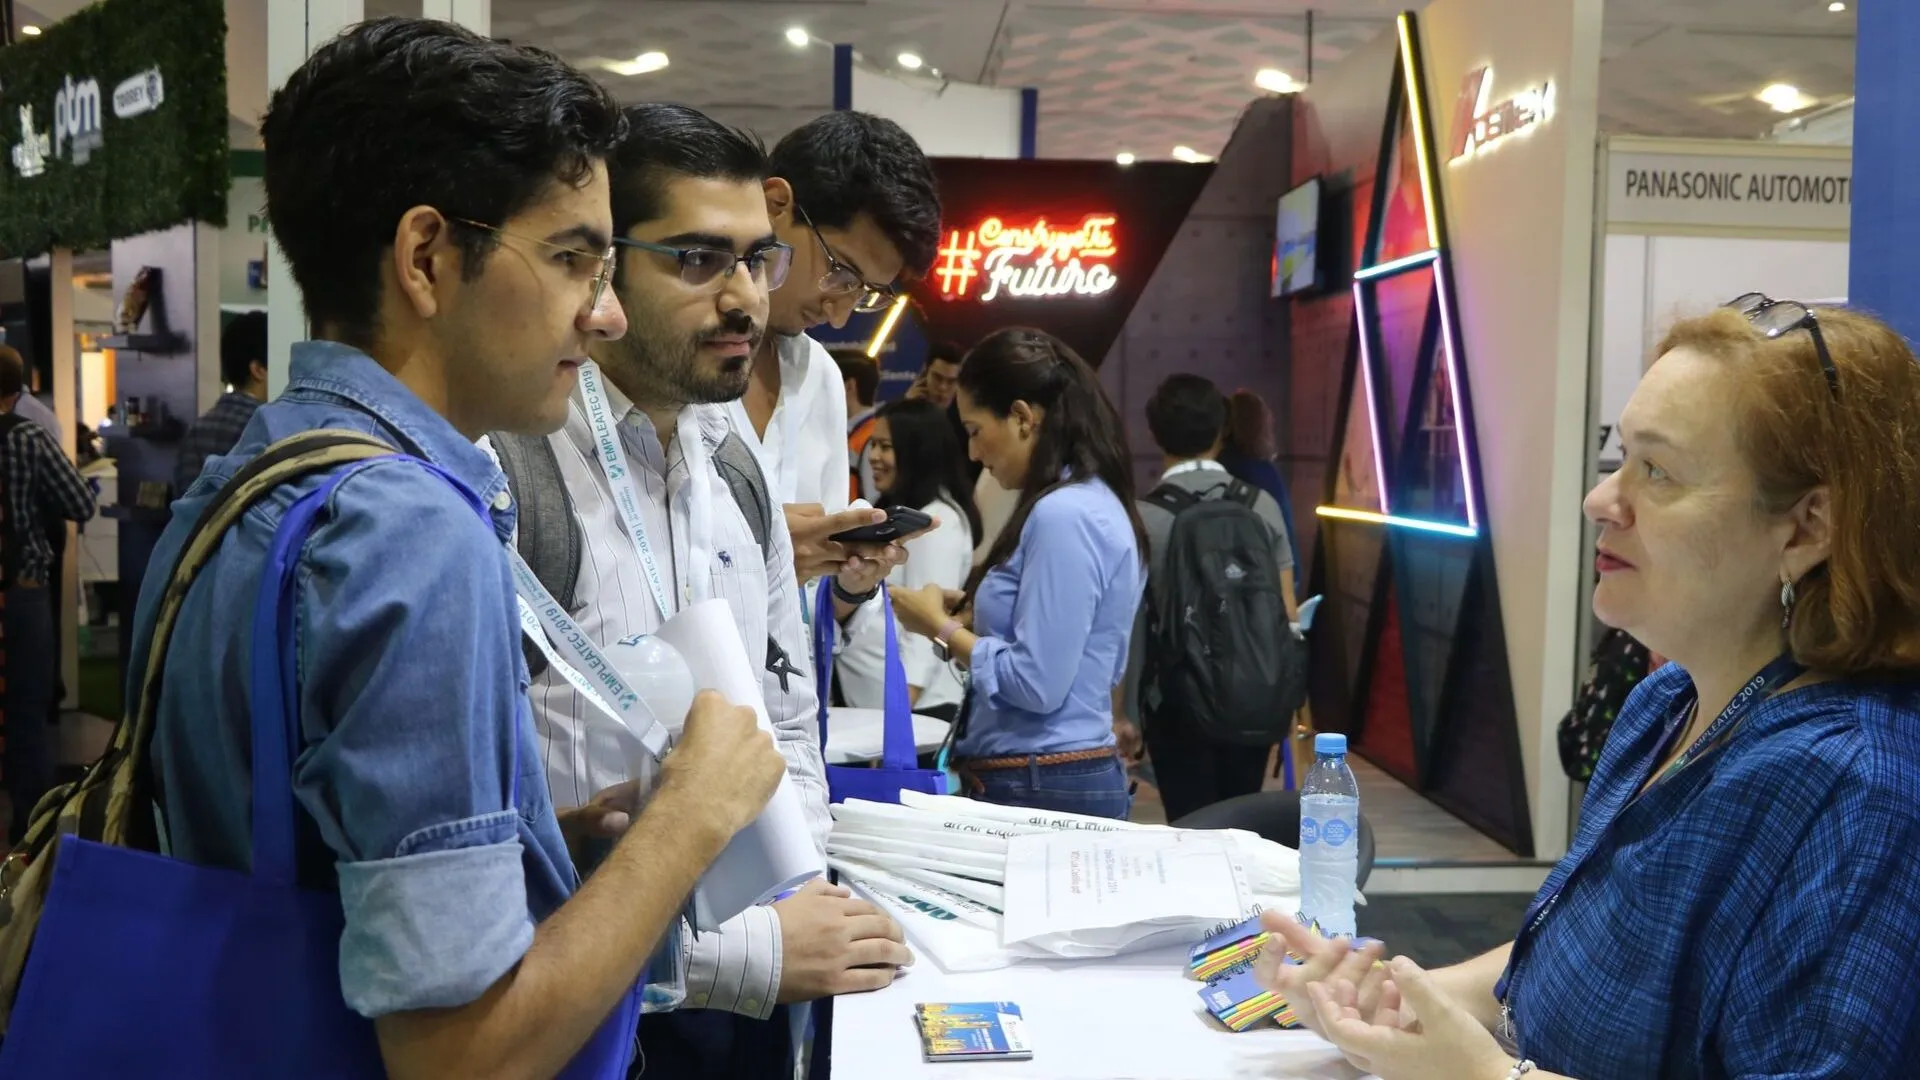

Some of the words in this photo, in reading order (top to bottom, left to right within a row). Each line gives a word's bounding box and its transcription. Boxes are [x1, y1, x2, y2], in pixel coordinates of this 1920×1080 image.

[1626, 169, 1742, 201] PANASONIC
[981, 247, 1117, 301] Futuro
[583, 369, 596, 395] 2019
[588, 395, 617, 464] EMPLEATEC
[635, 529, 649, 554] 2019
[545, 607, 573, 634] 2019
[567, 632, 624, 696] EMPLEATEC
[1689, 703, 1741, 753] EMPLEATEC
[1739, 675, 1765, 704] 2019
